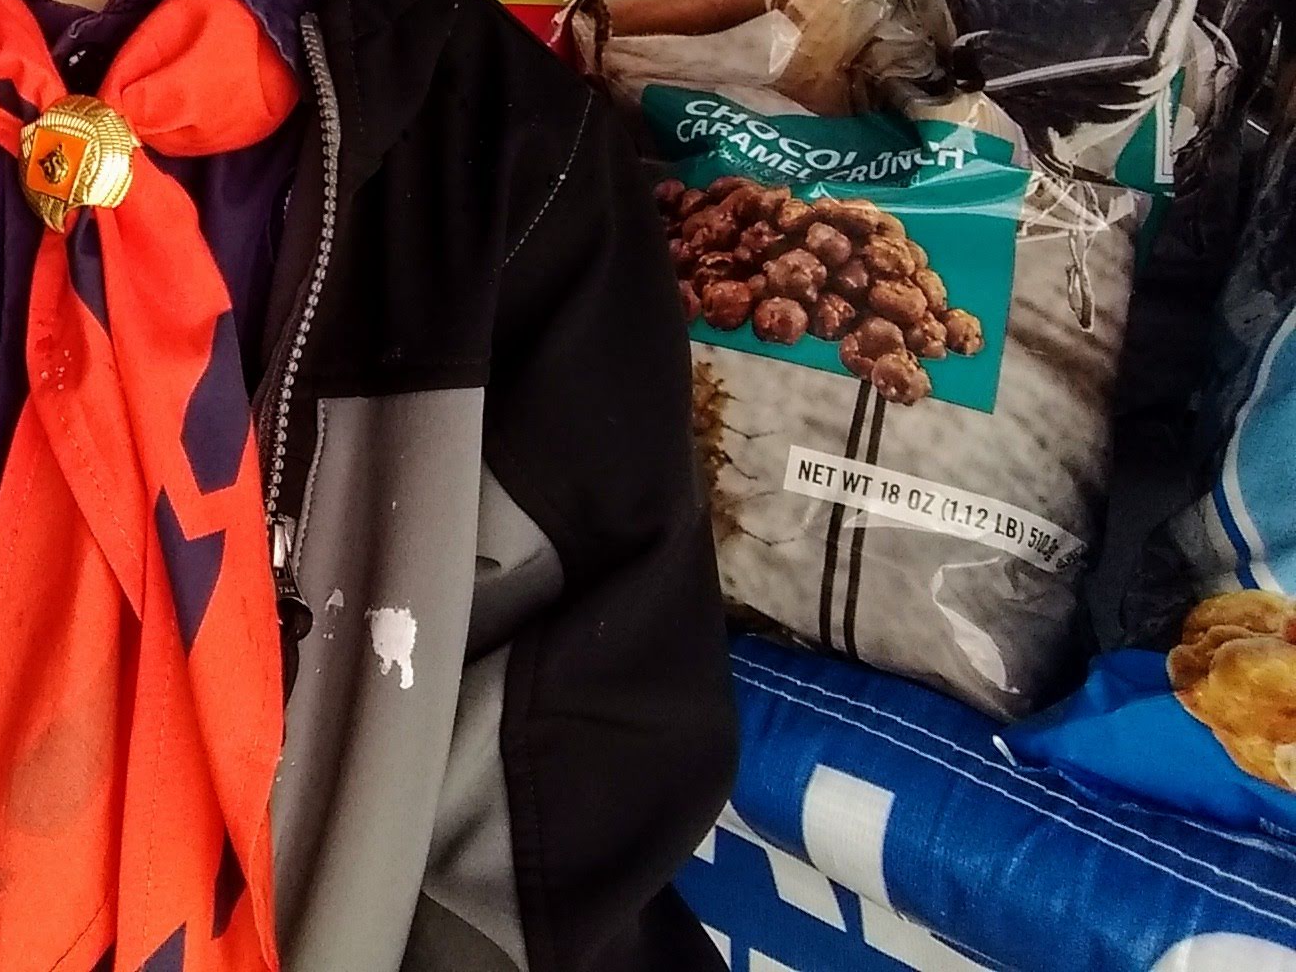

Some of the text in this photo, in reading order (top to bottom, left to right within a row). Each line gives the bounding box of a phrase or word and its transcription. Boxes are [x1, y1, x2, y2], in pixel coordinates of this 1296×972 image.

[676, 118, 816, 183] CARAMEL
[797, 459, 837, 488] NET
[841, 470, 874, 497] WT
[879, 480, 901, 505] 18
[907, 488, 937, 516] OZ
[940, 497, 989, 530] (1.12
[994, 513, 1025, 545] LB)
